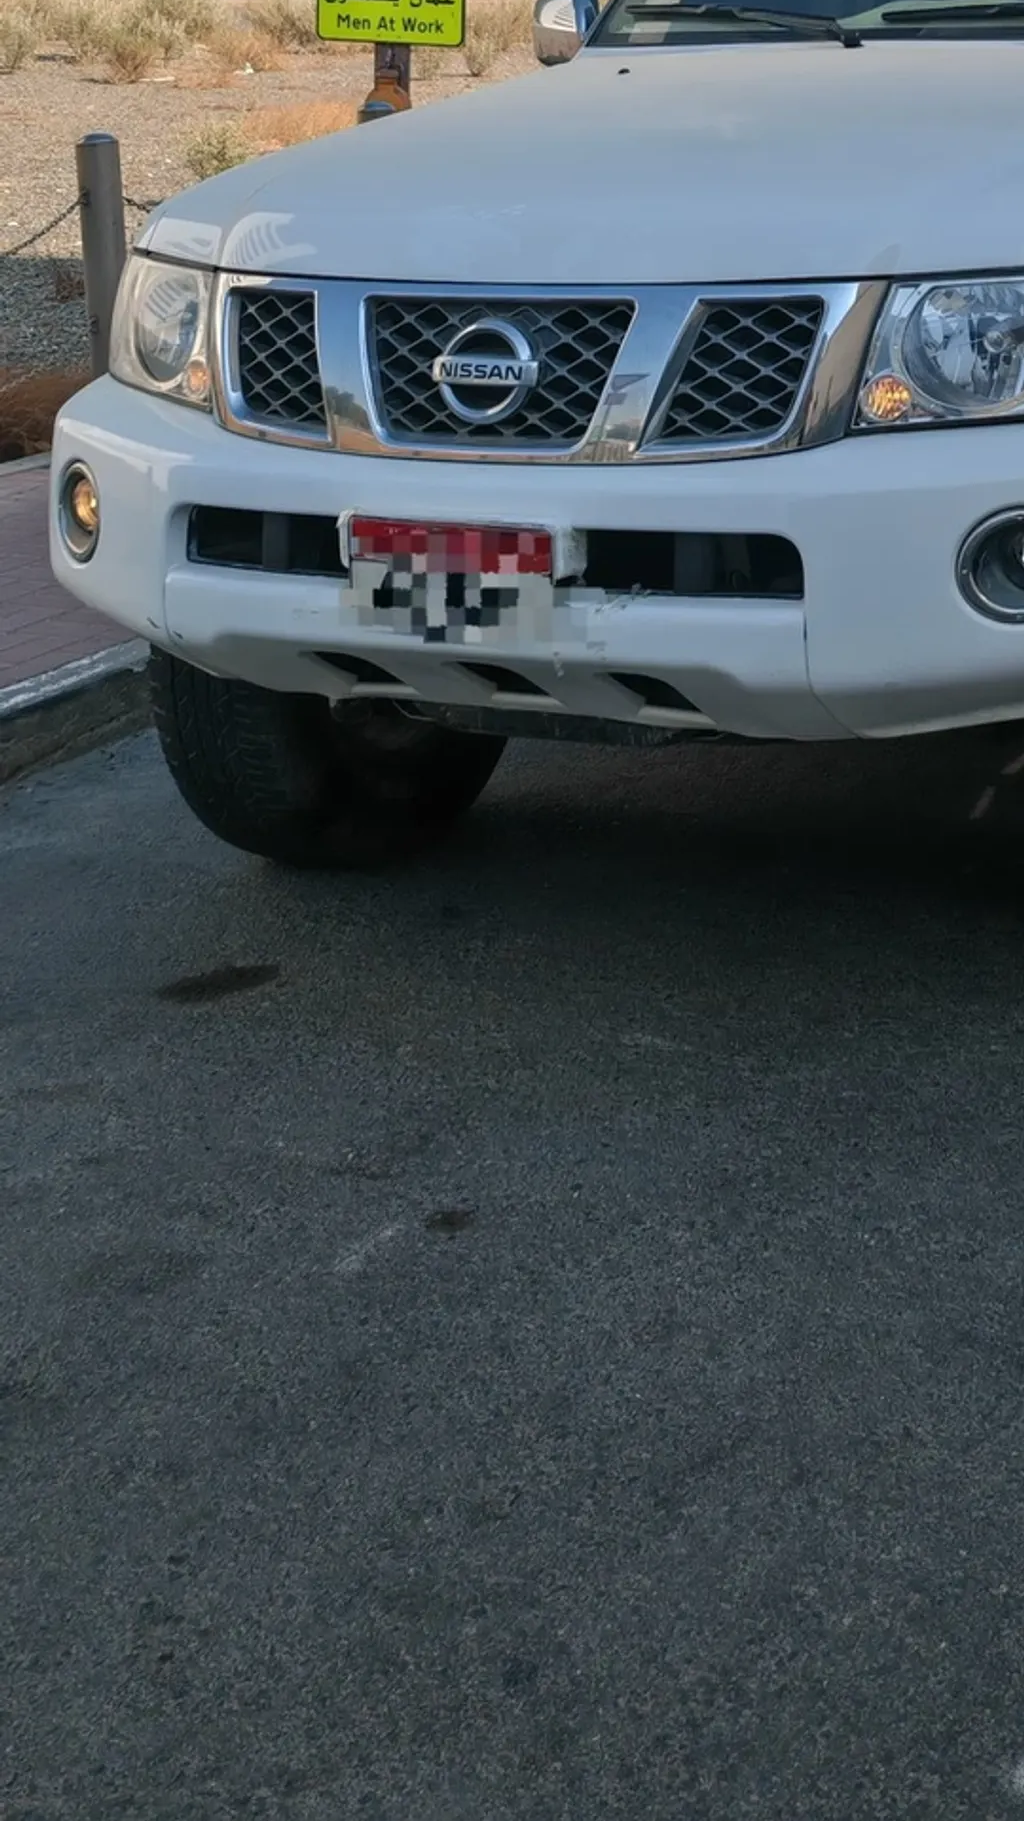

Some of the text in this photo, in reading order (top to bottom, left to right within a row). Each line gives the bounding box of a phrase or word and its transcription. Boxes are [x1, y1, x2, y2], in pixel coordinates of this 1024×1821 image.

[336, 13, 445, 34] Men At Work
[439, 362, 523, 381] NISSAN
